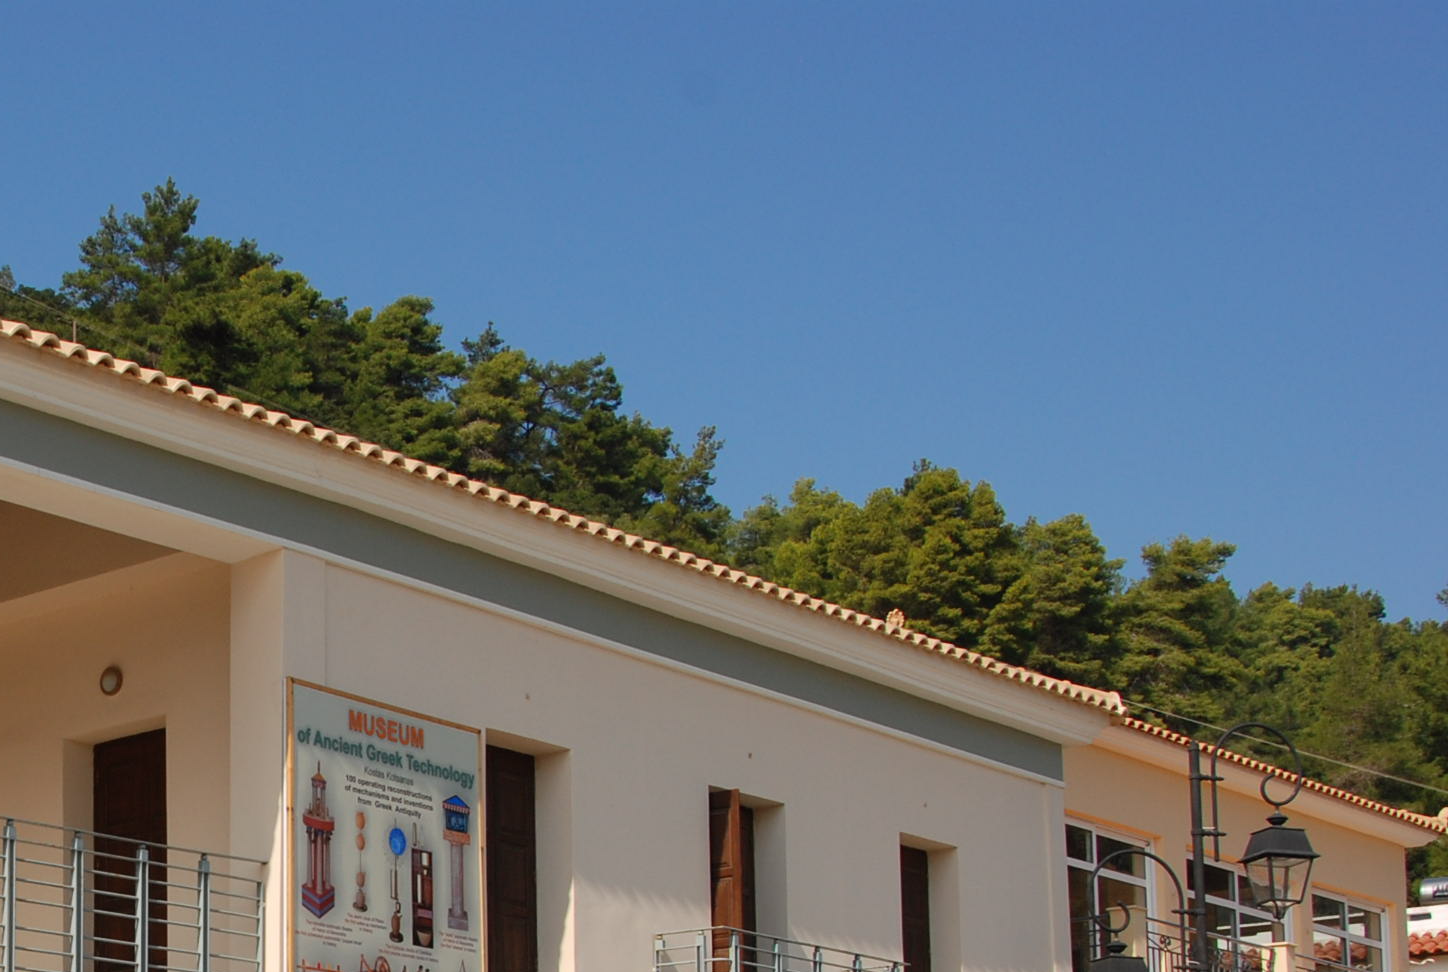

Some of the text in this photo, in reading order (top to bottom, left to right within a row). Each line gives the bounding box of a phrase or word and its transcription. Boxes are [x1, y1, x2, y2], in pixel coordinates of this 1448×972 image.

[348, 709, 425, 749] MUSEUM
[297, 728, 475, 790] of Ancient Greek Technology
[344, 784, 434, 812] of mechanisms and inventions
[357, 778, 386, 793] operating
[387, 783, 433, 802] reconstructions
[357, 797, 422, 820] from Greek Antiquity
